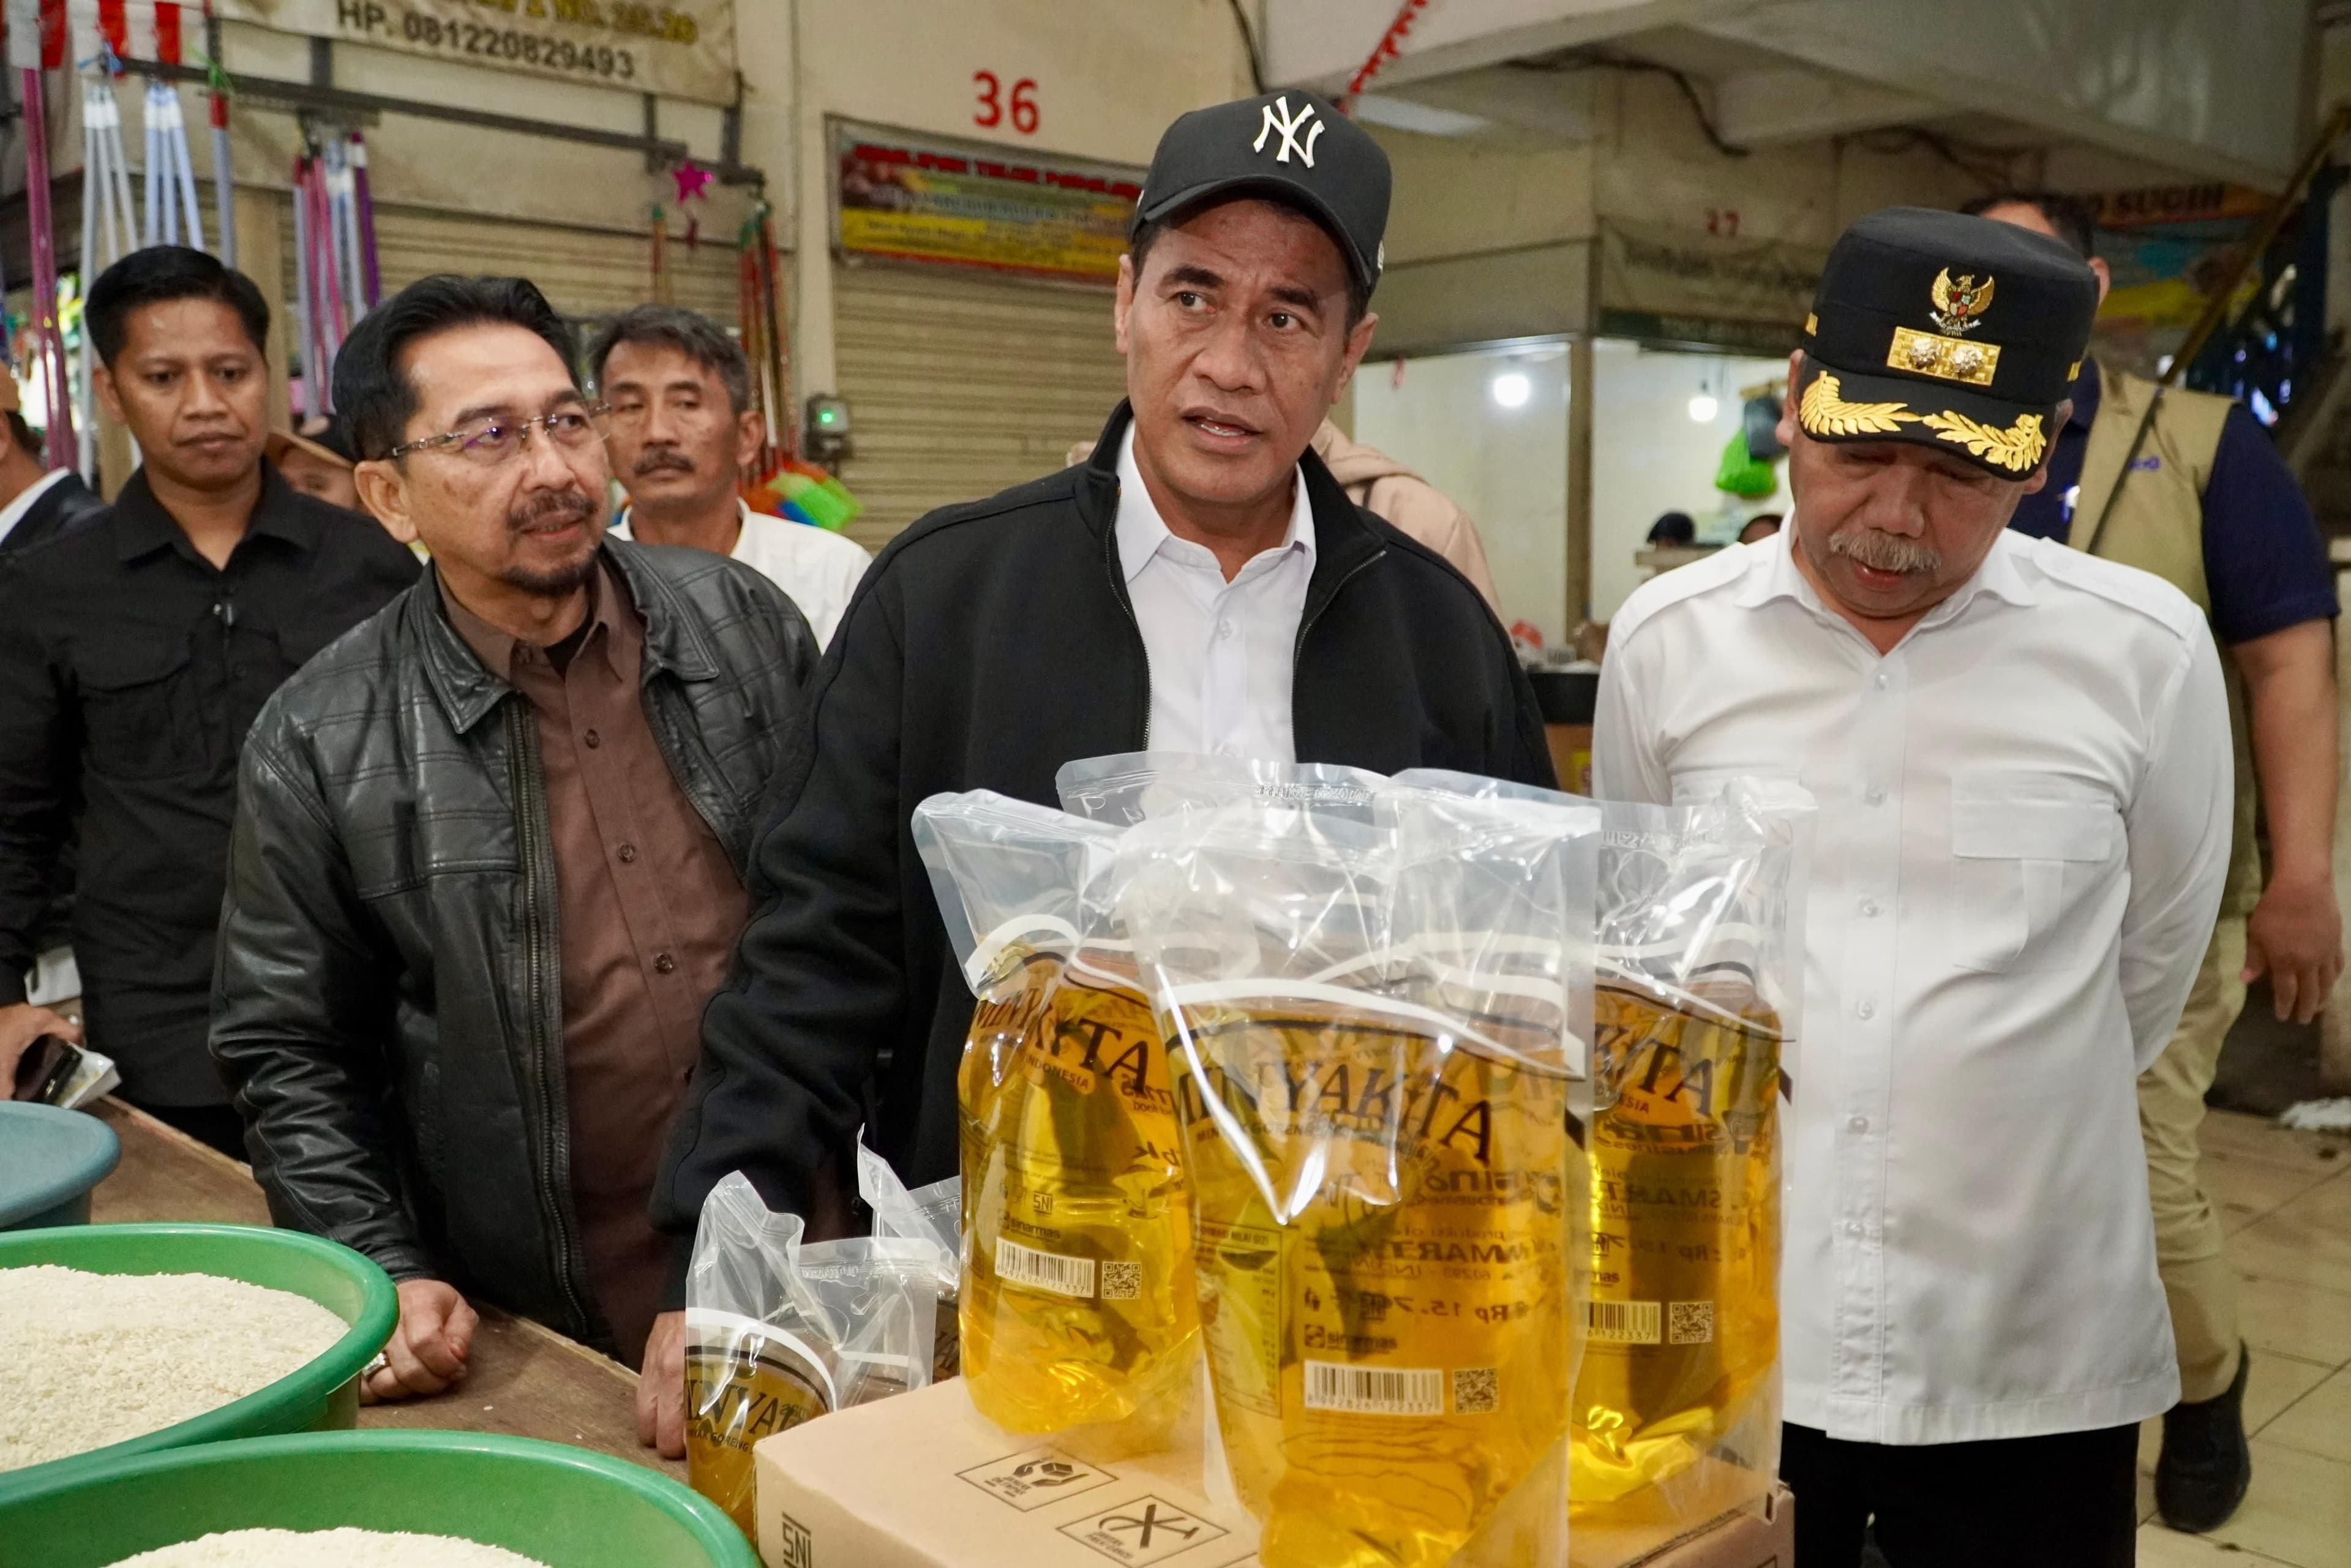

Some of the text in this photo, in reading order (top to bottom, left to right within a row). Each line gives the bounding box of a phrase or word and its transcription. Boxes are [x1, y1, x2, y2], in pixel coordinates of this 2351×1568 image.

[336, 0, 393, 37] HP.
[403, 11, 635, 80] 081220829493
[973, 70, 1040, 135] 36
[1033, 1195, 1053, 1212] SNI
[1011, 1218, 1061, 1239] sinarmas
[710, 1433, 749, 1452] GORENG
[782, 1521, 811, 1568] SNI
